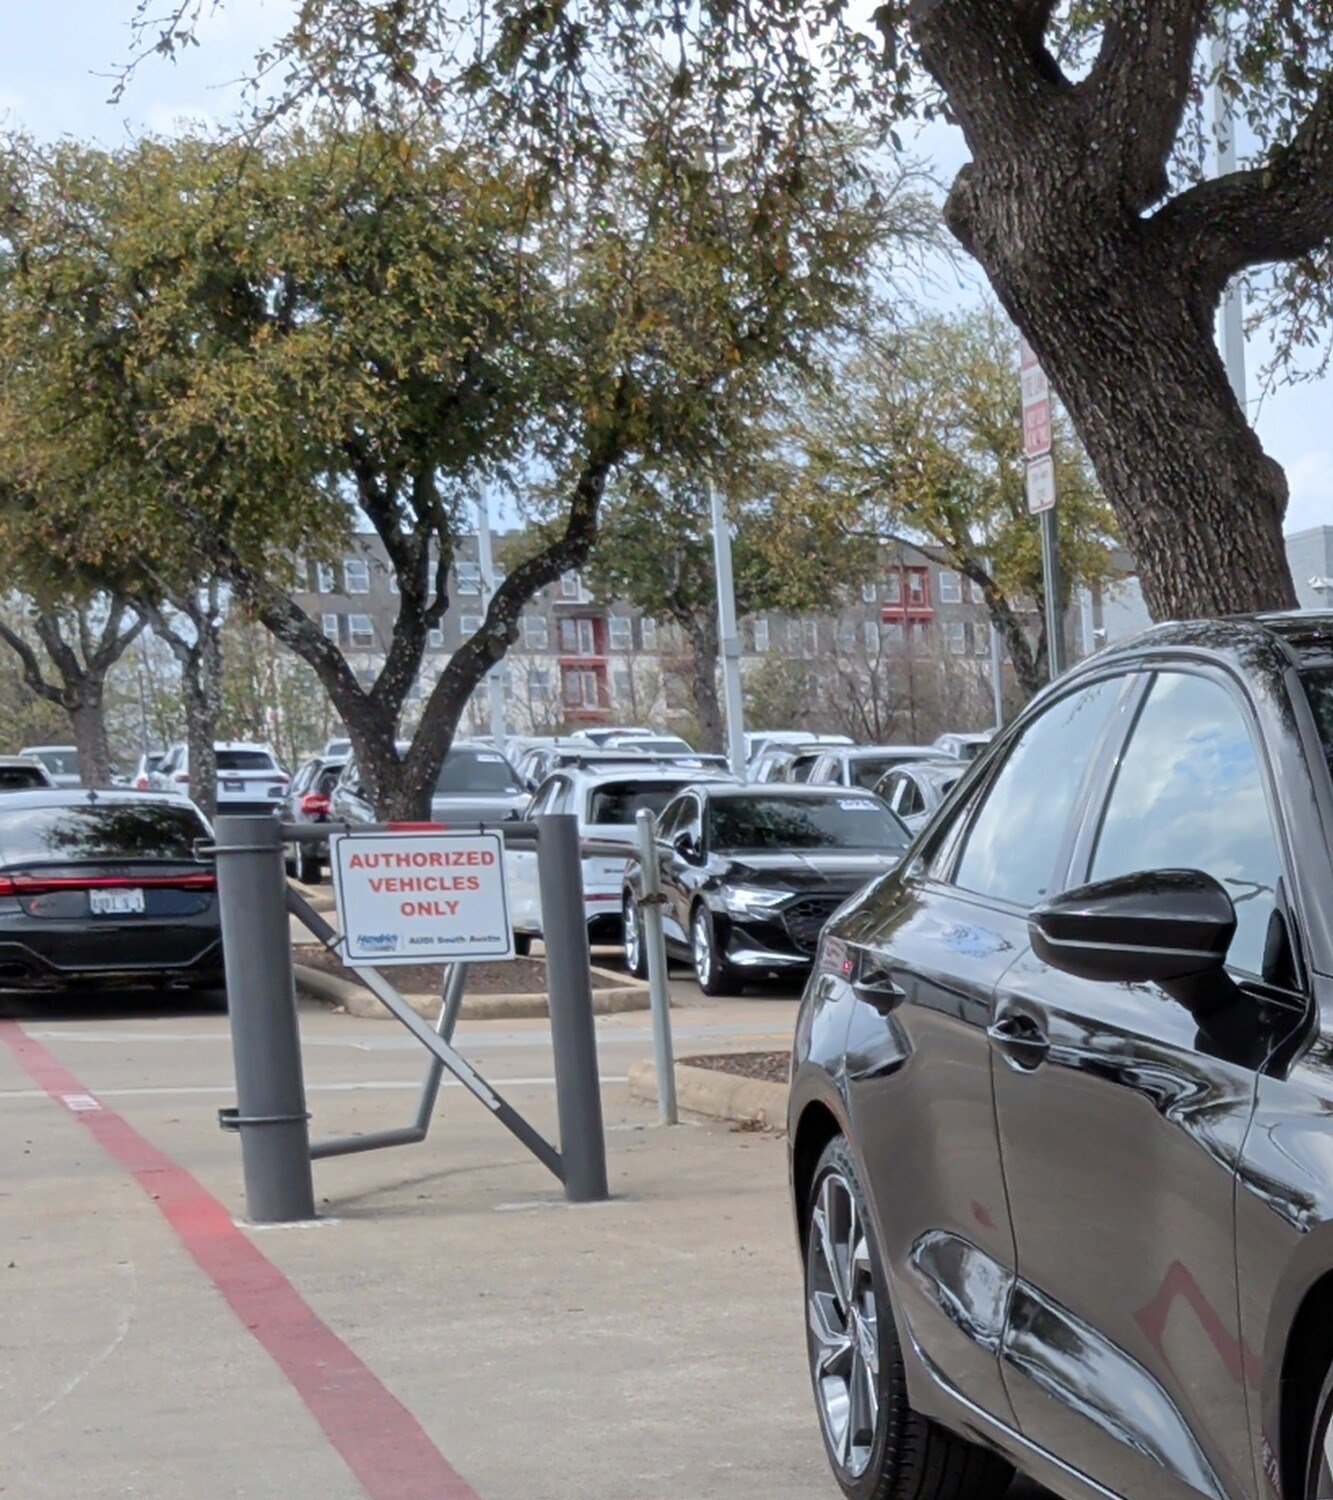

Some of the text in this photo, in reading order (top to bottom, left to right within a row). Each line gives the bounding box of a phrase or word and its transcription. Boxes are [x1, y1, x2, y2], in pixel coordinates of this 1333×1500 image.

[349, 851, 495, 869] AUTHORIZED
[368, 876, 480, 893] VEHICLES
[400, 901, 460, 917] ONLY
